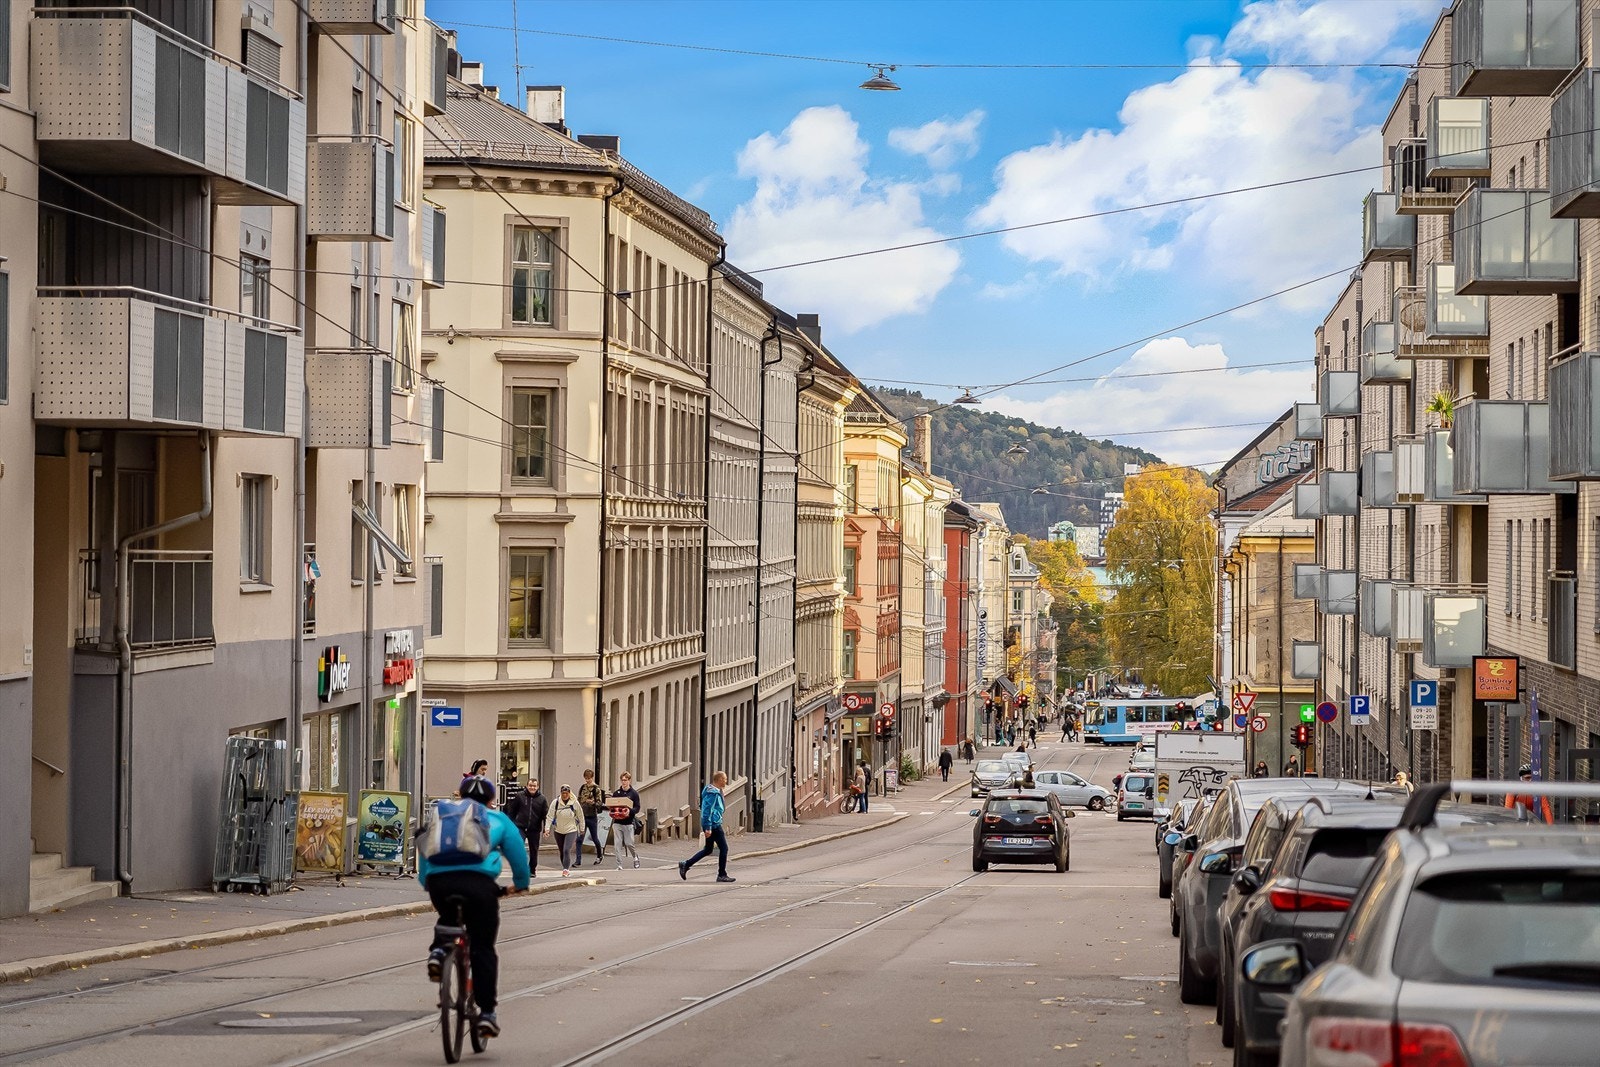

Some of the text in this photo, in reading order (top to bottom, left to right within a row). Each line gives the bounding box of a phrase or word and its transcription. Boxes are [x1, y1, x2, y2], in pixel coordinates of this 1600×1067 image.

[328, 646, 351, 702] joker
[1479, 676, 1512, 684] Bombay
[1417, 683, 1431, 704] P
[1355, 698, 1365, 713] P
